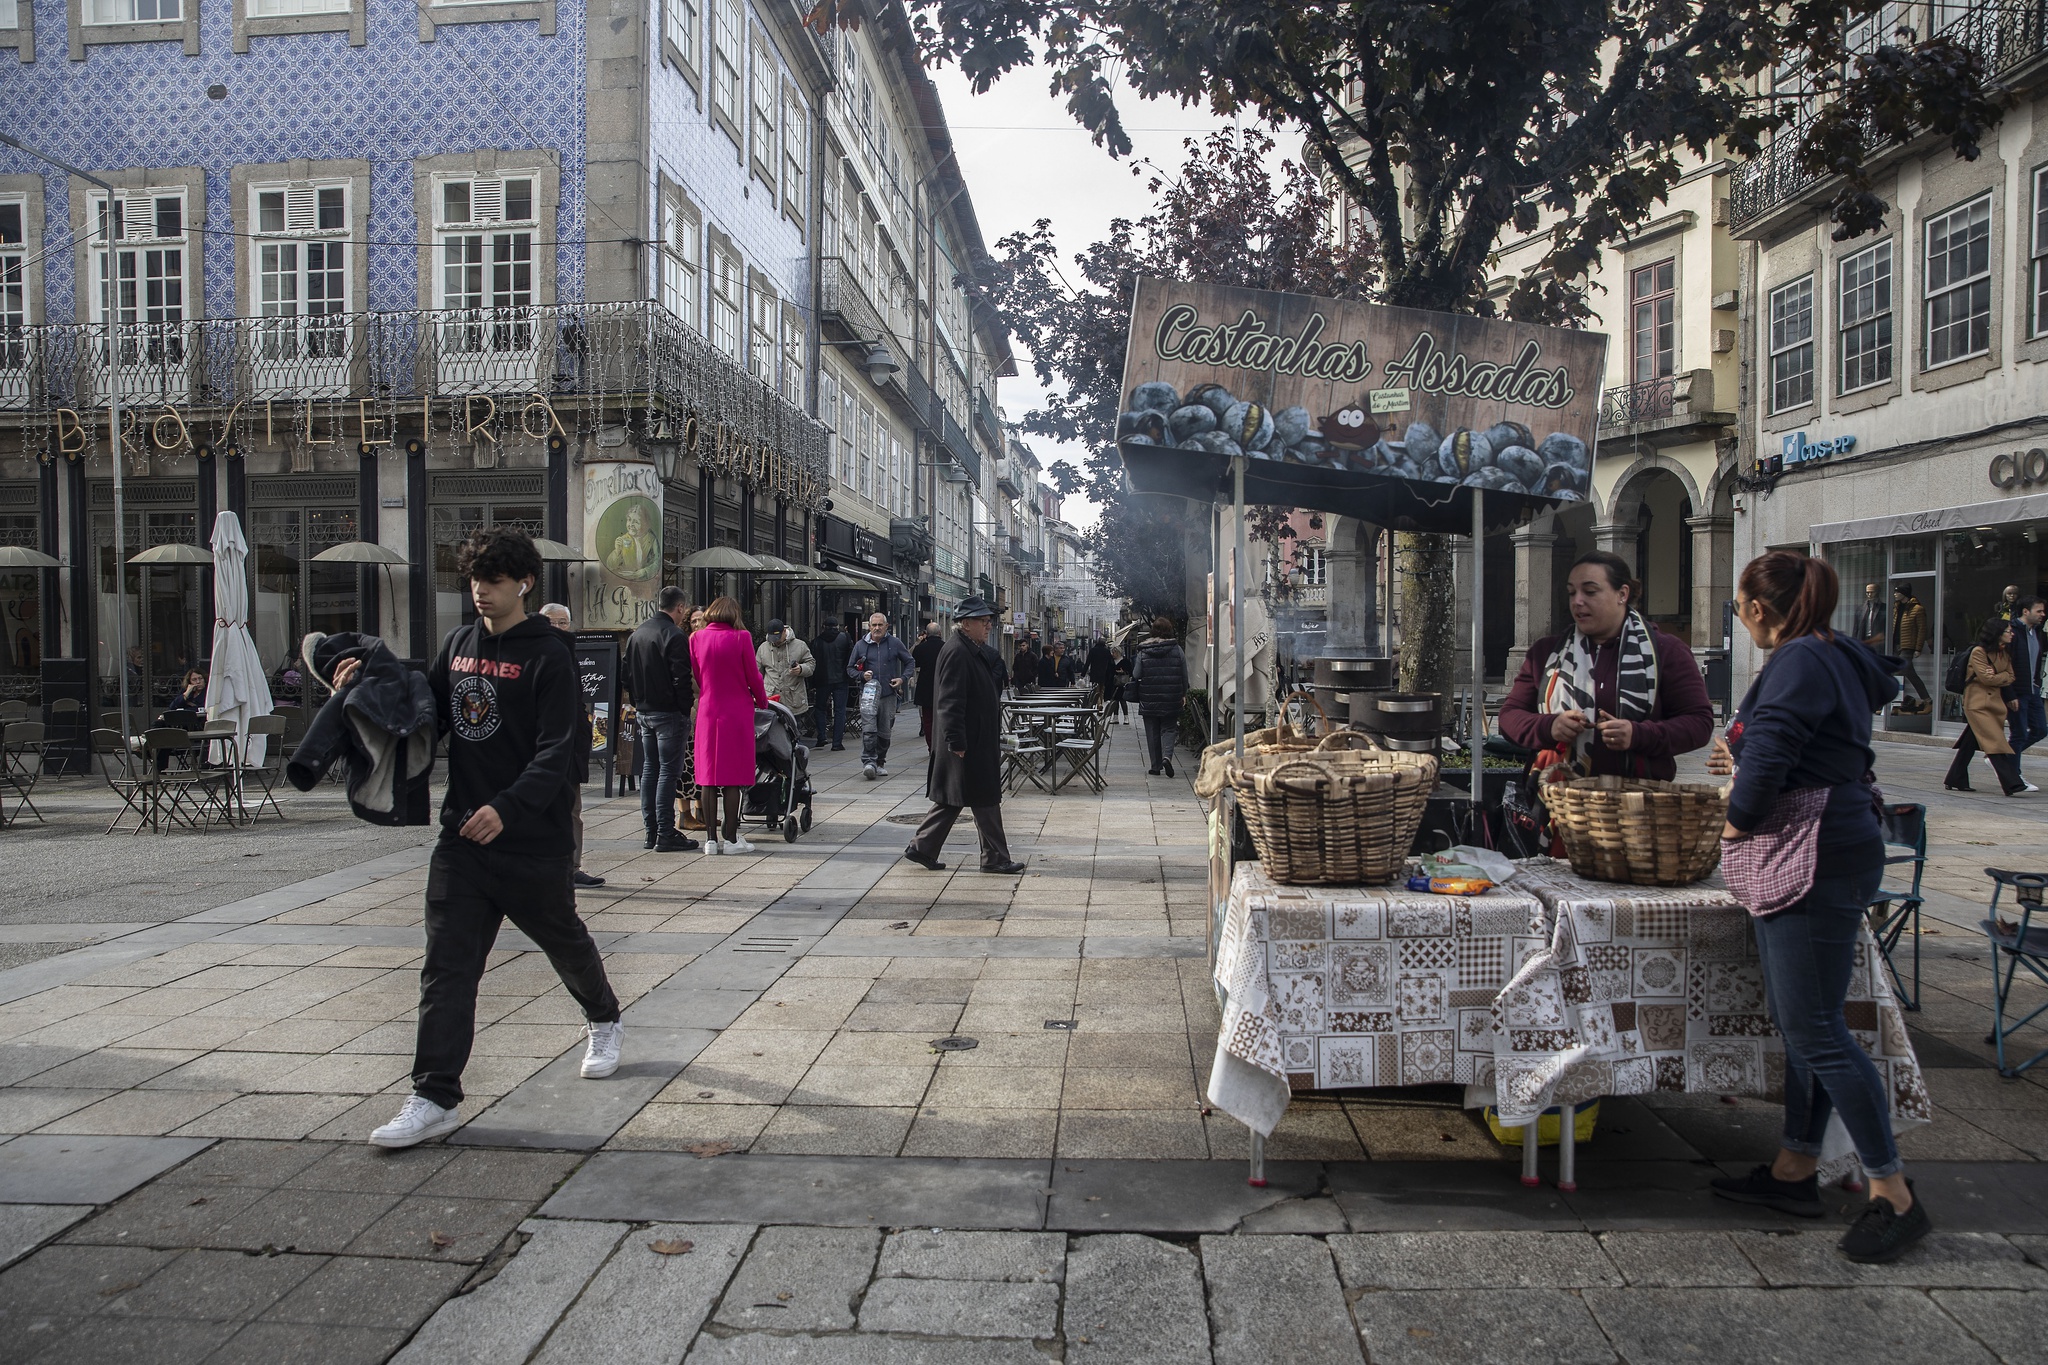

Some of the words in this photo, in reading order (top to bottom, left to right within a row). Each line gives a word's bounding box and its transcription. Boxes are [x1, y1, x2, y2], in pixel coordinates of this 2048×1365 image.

[1156, 304, 1372, 382] Castanhas
[1383, 331, 1575, 409] Assadas
[1372, 391, 1405, 402] Castanhas
[1801, 434, 1857, 461] CDS-PP
[1911, 509, 1945, 532] Closed
[451, 655, 522, 679] RAMONES
